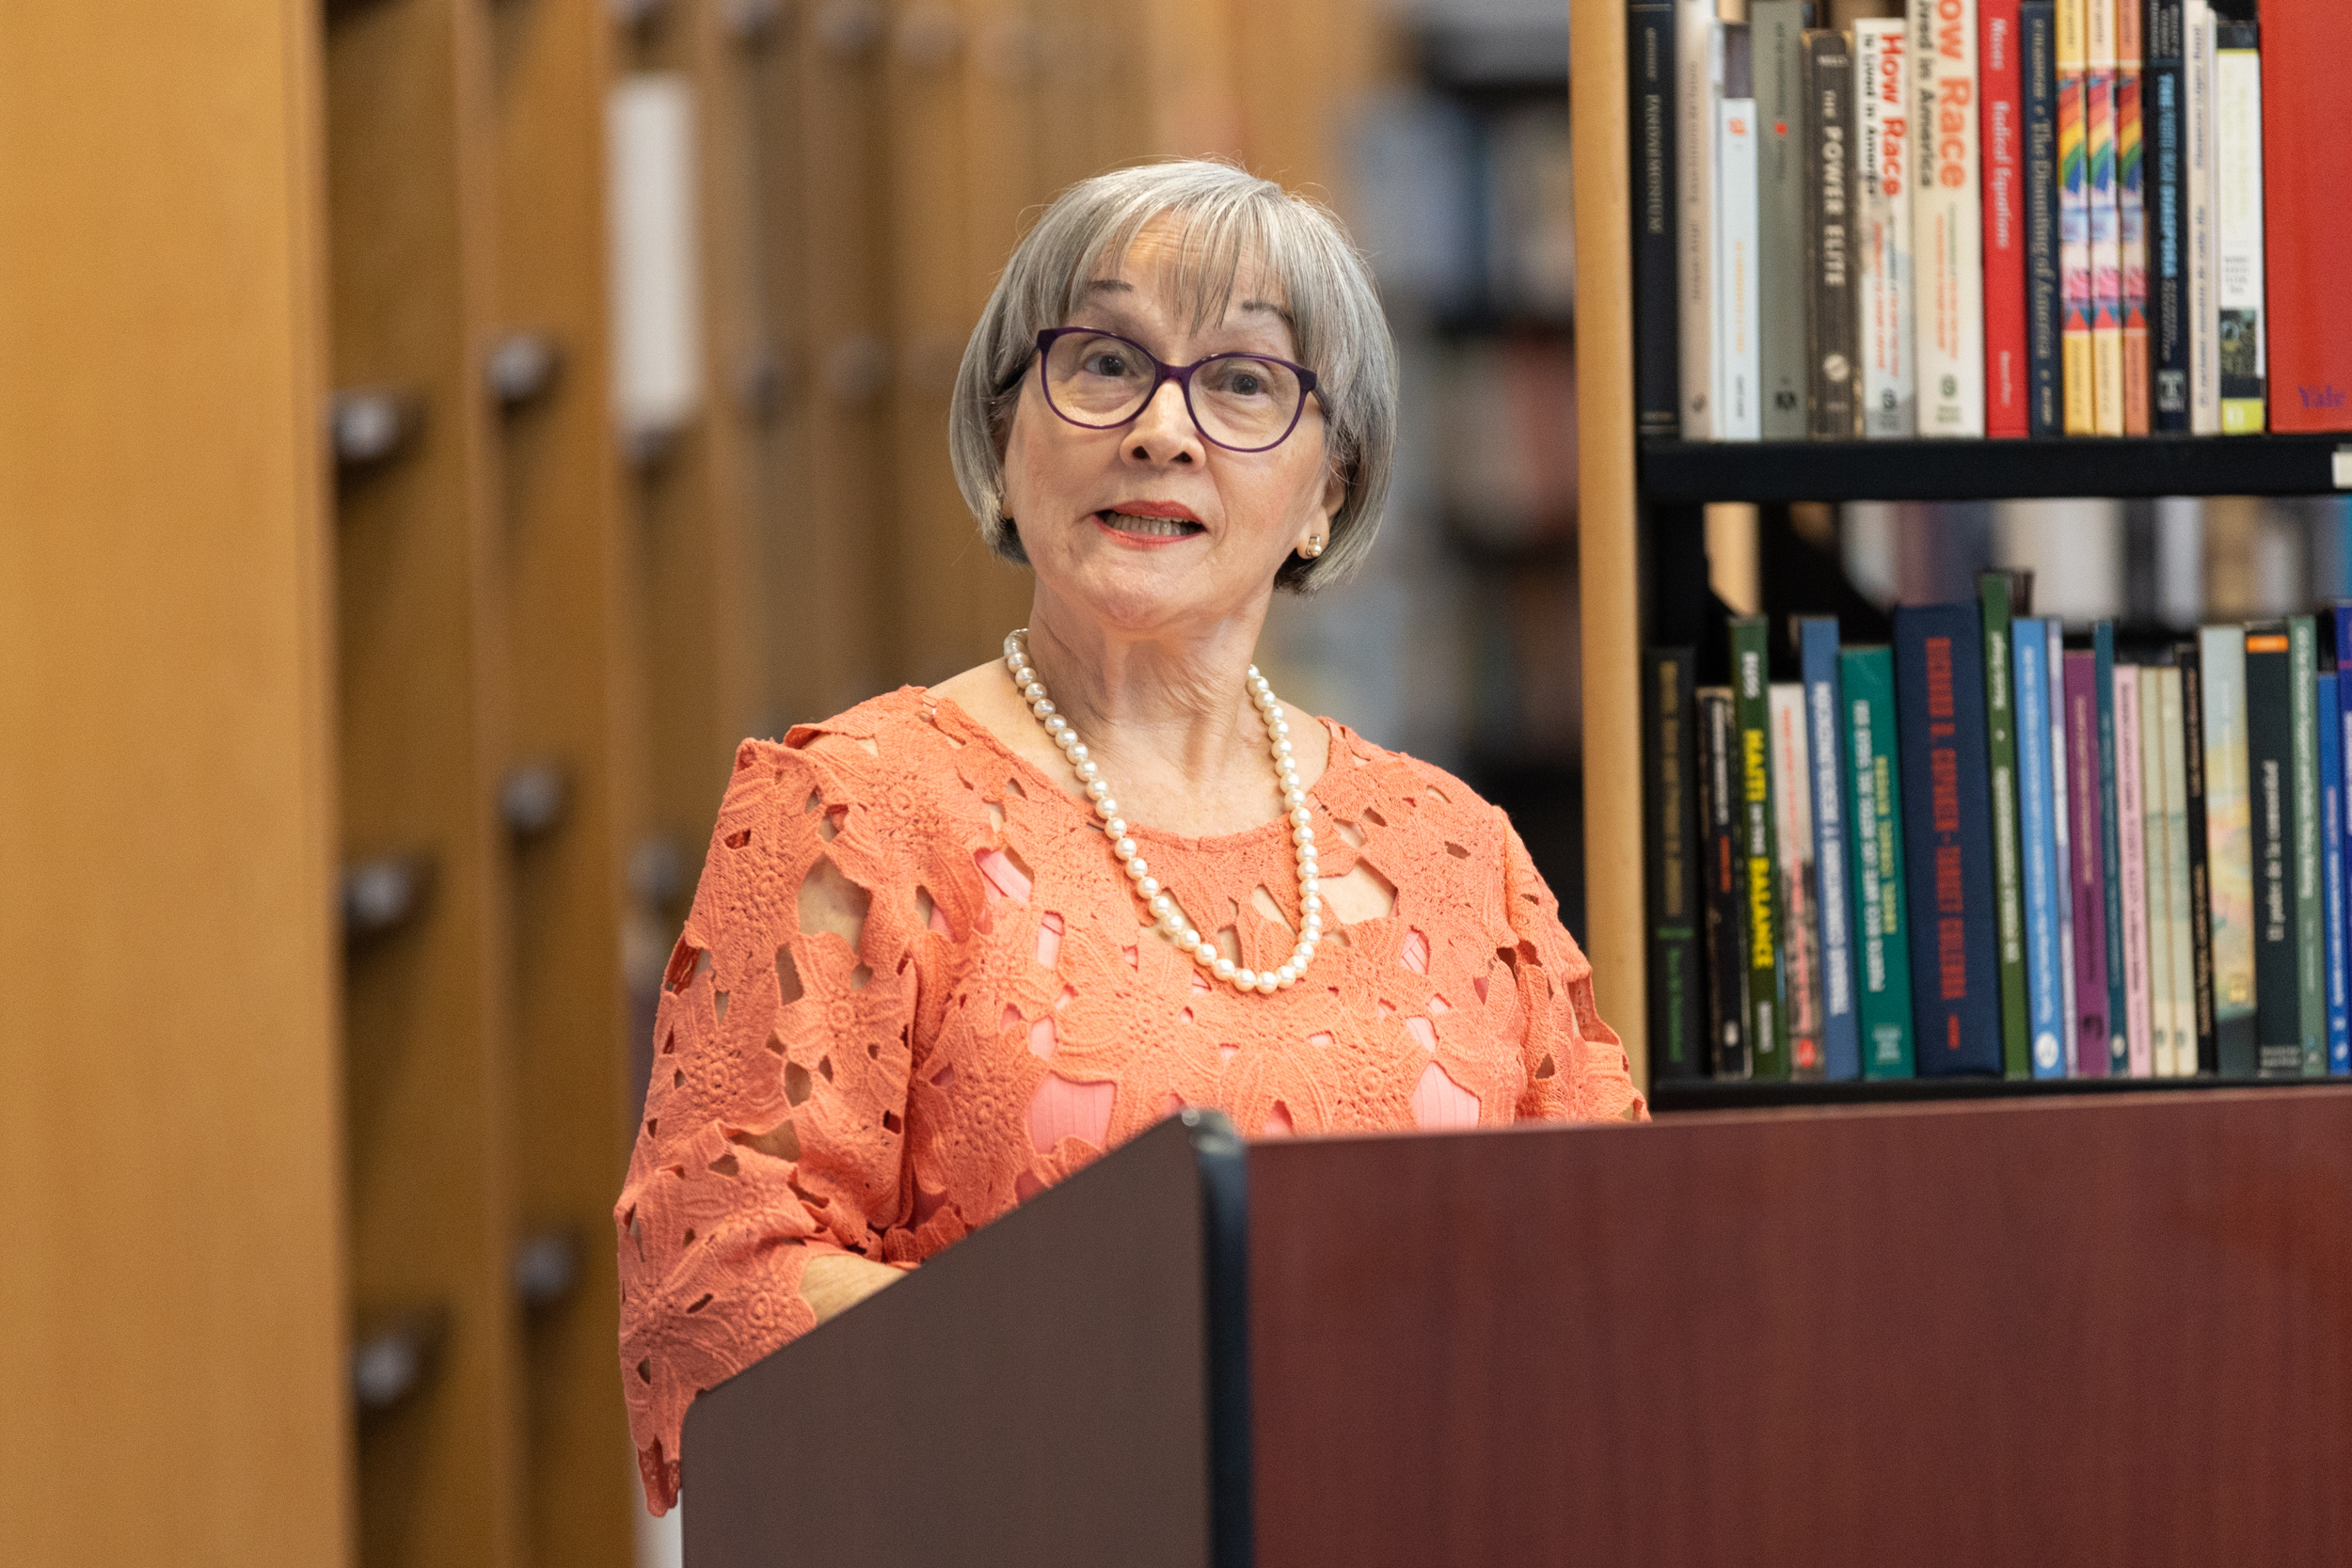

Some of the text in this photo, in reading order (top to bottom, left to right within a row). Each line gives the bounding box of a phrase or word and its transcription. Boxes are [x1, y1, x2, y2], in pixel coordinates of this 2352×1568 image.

[1939, 0, 1963, 60] ow
[1990, 17, 2009, 71] Moses
[1882, 35, 1903, 104] How
[1919, 58, 1935, 80] in
[1866, 103, 1877, 119] in
[1920, 88, 1936, 188] America
[1940, 78, 1971, 188] Race
[2032, 119, 2052, 156] The
[1645, 95, 1664, 233] PANDAEMONIUM
[1822, 125, 1844, 215] POWER
[1883, 118, 1907, 197] Race
[1992, 101, 2013, 249] Radical Equations
[2030, 159, 2052, 256] Disuniting
[2160, 184, 2178, 277] DIASPORA
[1823, 224, 1846, 286] ELITE
[2036, 257, 2057, 280] of
[2036, 280, 2055, 359] America
[2298, 385, 2346, 408] Yale
[1744, 728, 1767, 801] HAITI
[2263, 760, 2281, 841] comunidad
[2265, 841, 2282, 859] la
[2265, 860, 2282, 879] de
[1750, 856, 1774, 969] BALANCE
[2265, 882, 2286, 924] poder
